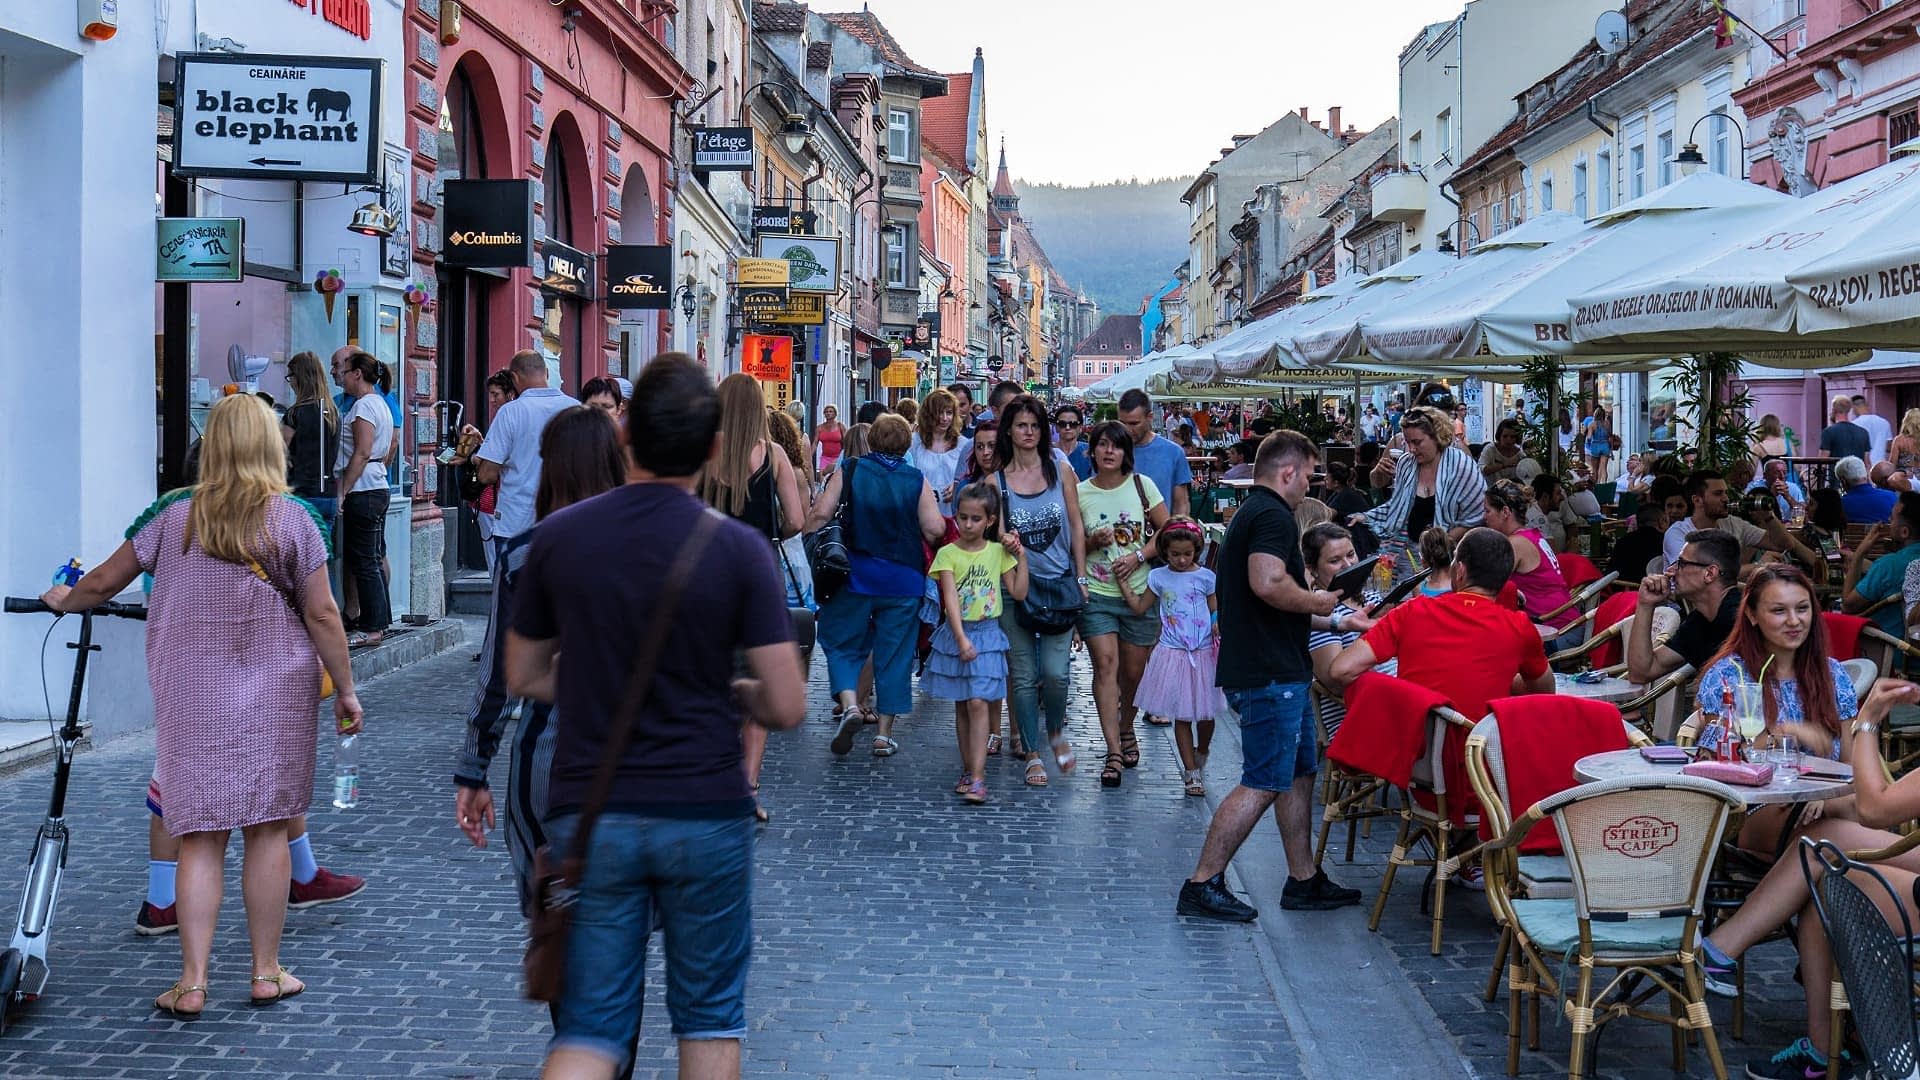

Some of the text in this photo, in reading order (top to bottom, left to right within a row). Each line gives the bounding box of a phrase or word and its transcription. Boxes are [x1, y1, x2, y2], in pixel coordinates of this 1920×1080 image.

[196, 89, 298, 115] black
[195, 115, 359, 144] elephant
[202, 238, 231, 256] TA
[463, 231, 522, 246] Columbia
[1878, 262, 1920, 299] REGE
[612, 285, 668, 294] O'NEILL
[1575, 301, 1609, 328] BRAȘOV.
[1611, 294, 1643, 319] REGELE
[1645, 289, 1698, 318] ORAȘELOR
[1534, 323, 1569, 341] BR
[746, 363, 786, 373] Collection
[1028, 532, 1046, 545] LIFE
[1609, 825, 1671, 841] STREET
[1621, 839, 1659, 852] CAFE
